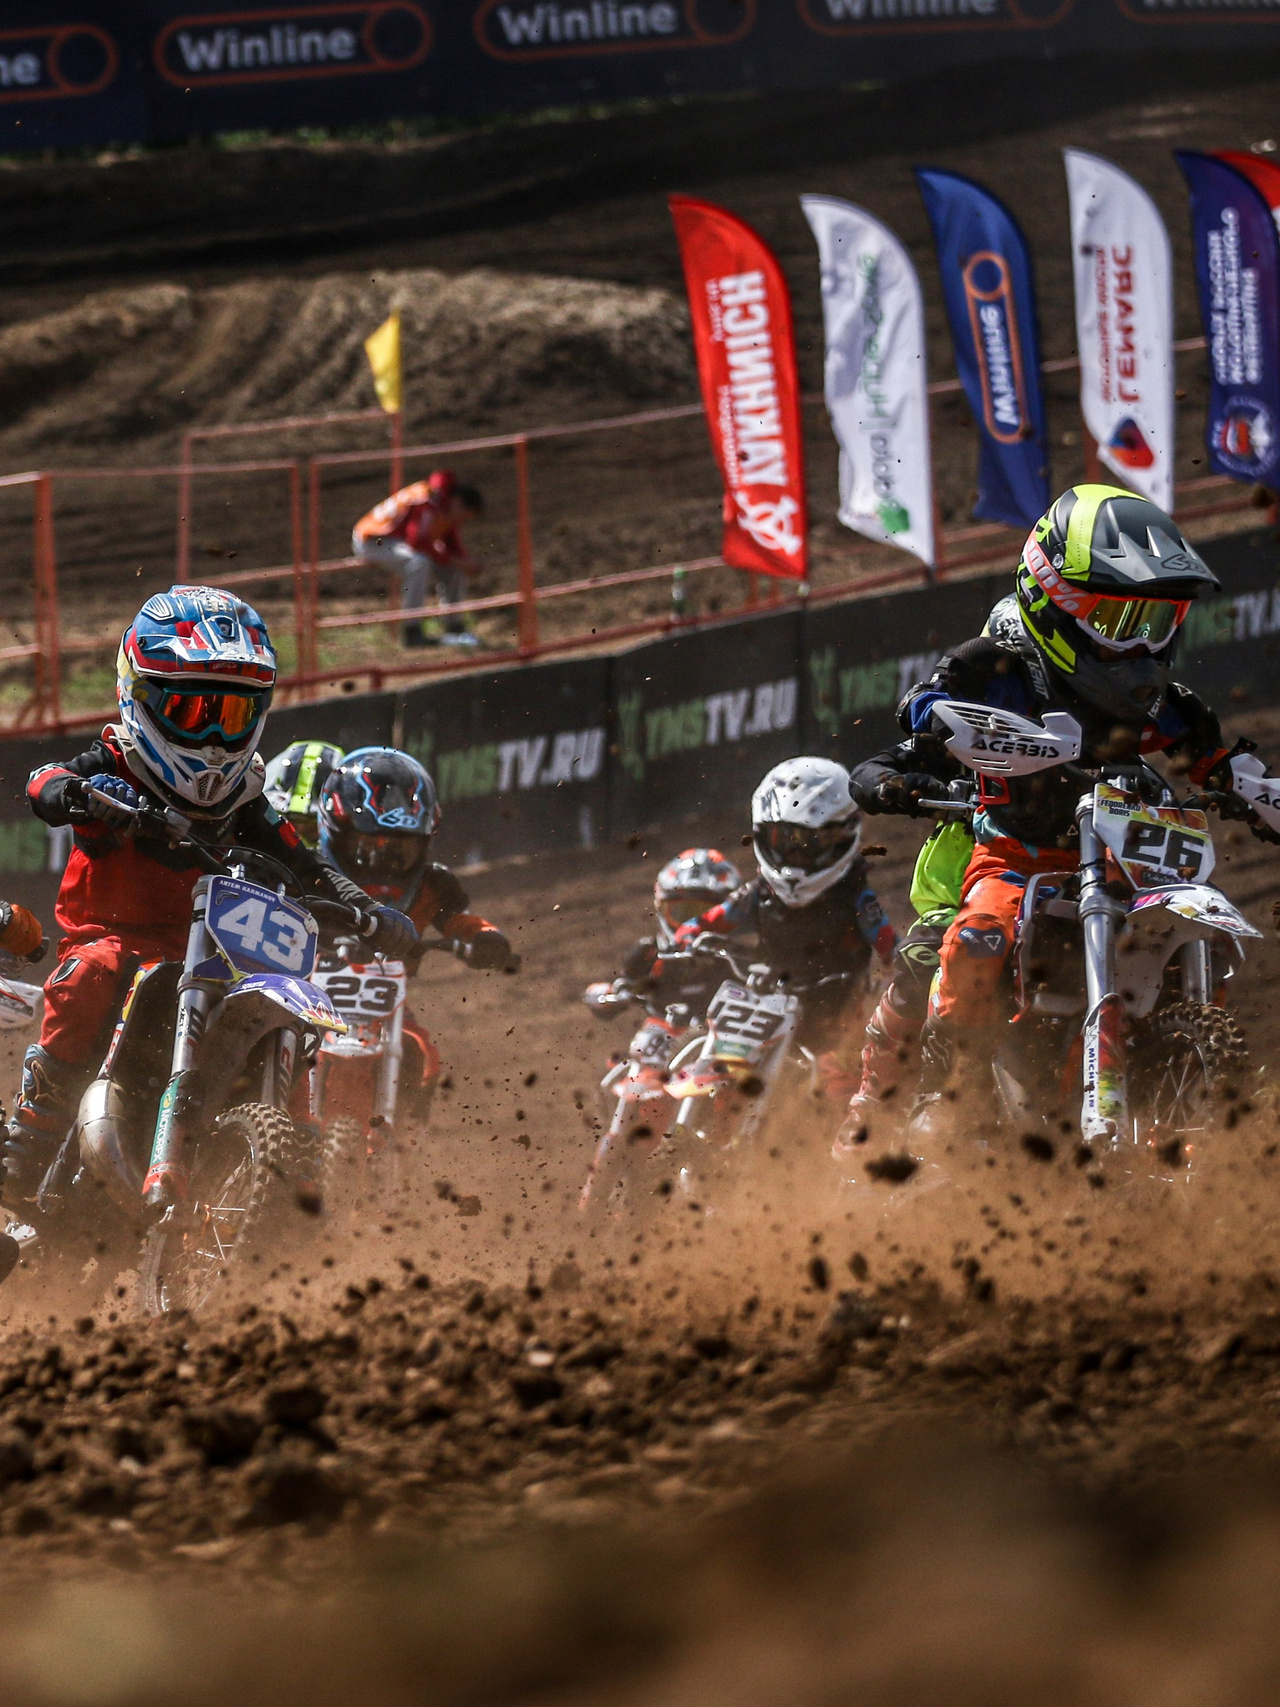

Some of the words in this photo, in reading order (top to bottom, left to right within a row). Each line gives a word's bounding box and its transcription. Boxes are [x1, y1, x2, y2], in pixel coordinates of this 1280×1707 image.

[497, 0, 678, 45] Winline
[177, 24, 356, 72] Winline
[646, 676, 798, 761] YMSTV.RU
[436, 724, 606, 802] YMSTV.RU
[971, 738, 1060, 760] ACERBIS
[1108, 809, 1131, 818] BORIS
[1121, 820, 1206, 881] 26
[219, 880, 241, 890] ARTEM
[217, 897, 310, 972] 43
[322, 975, 400, 1014] 23
[709, 1000, 786, 1042] 123
[153, 1108, 171, 1163] MOTOREX
